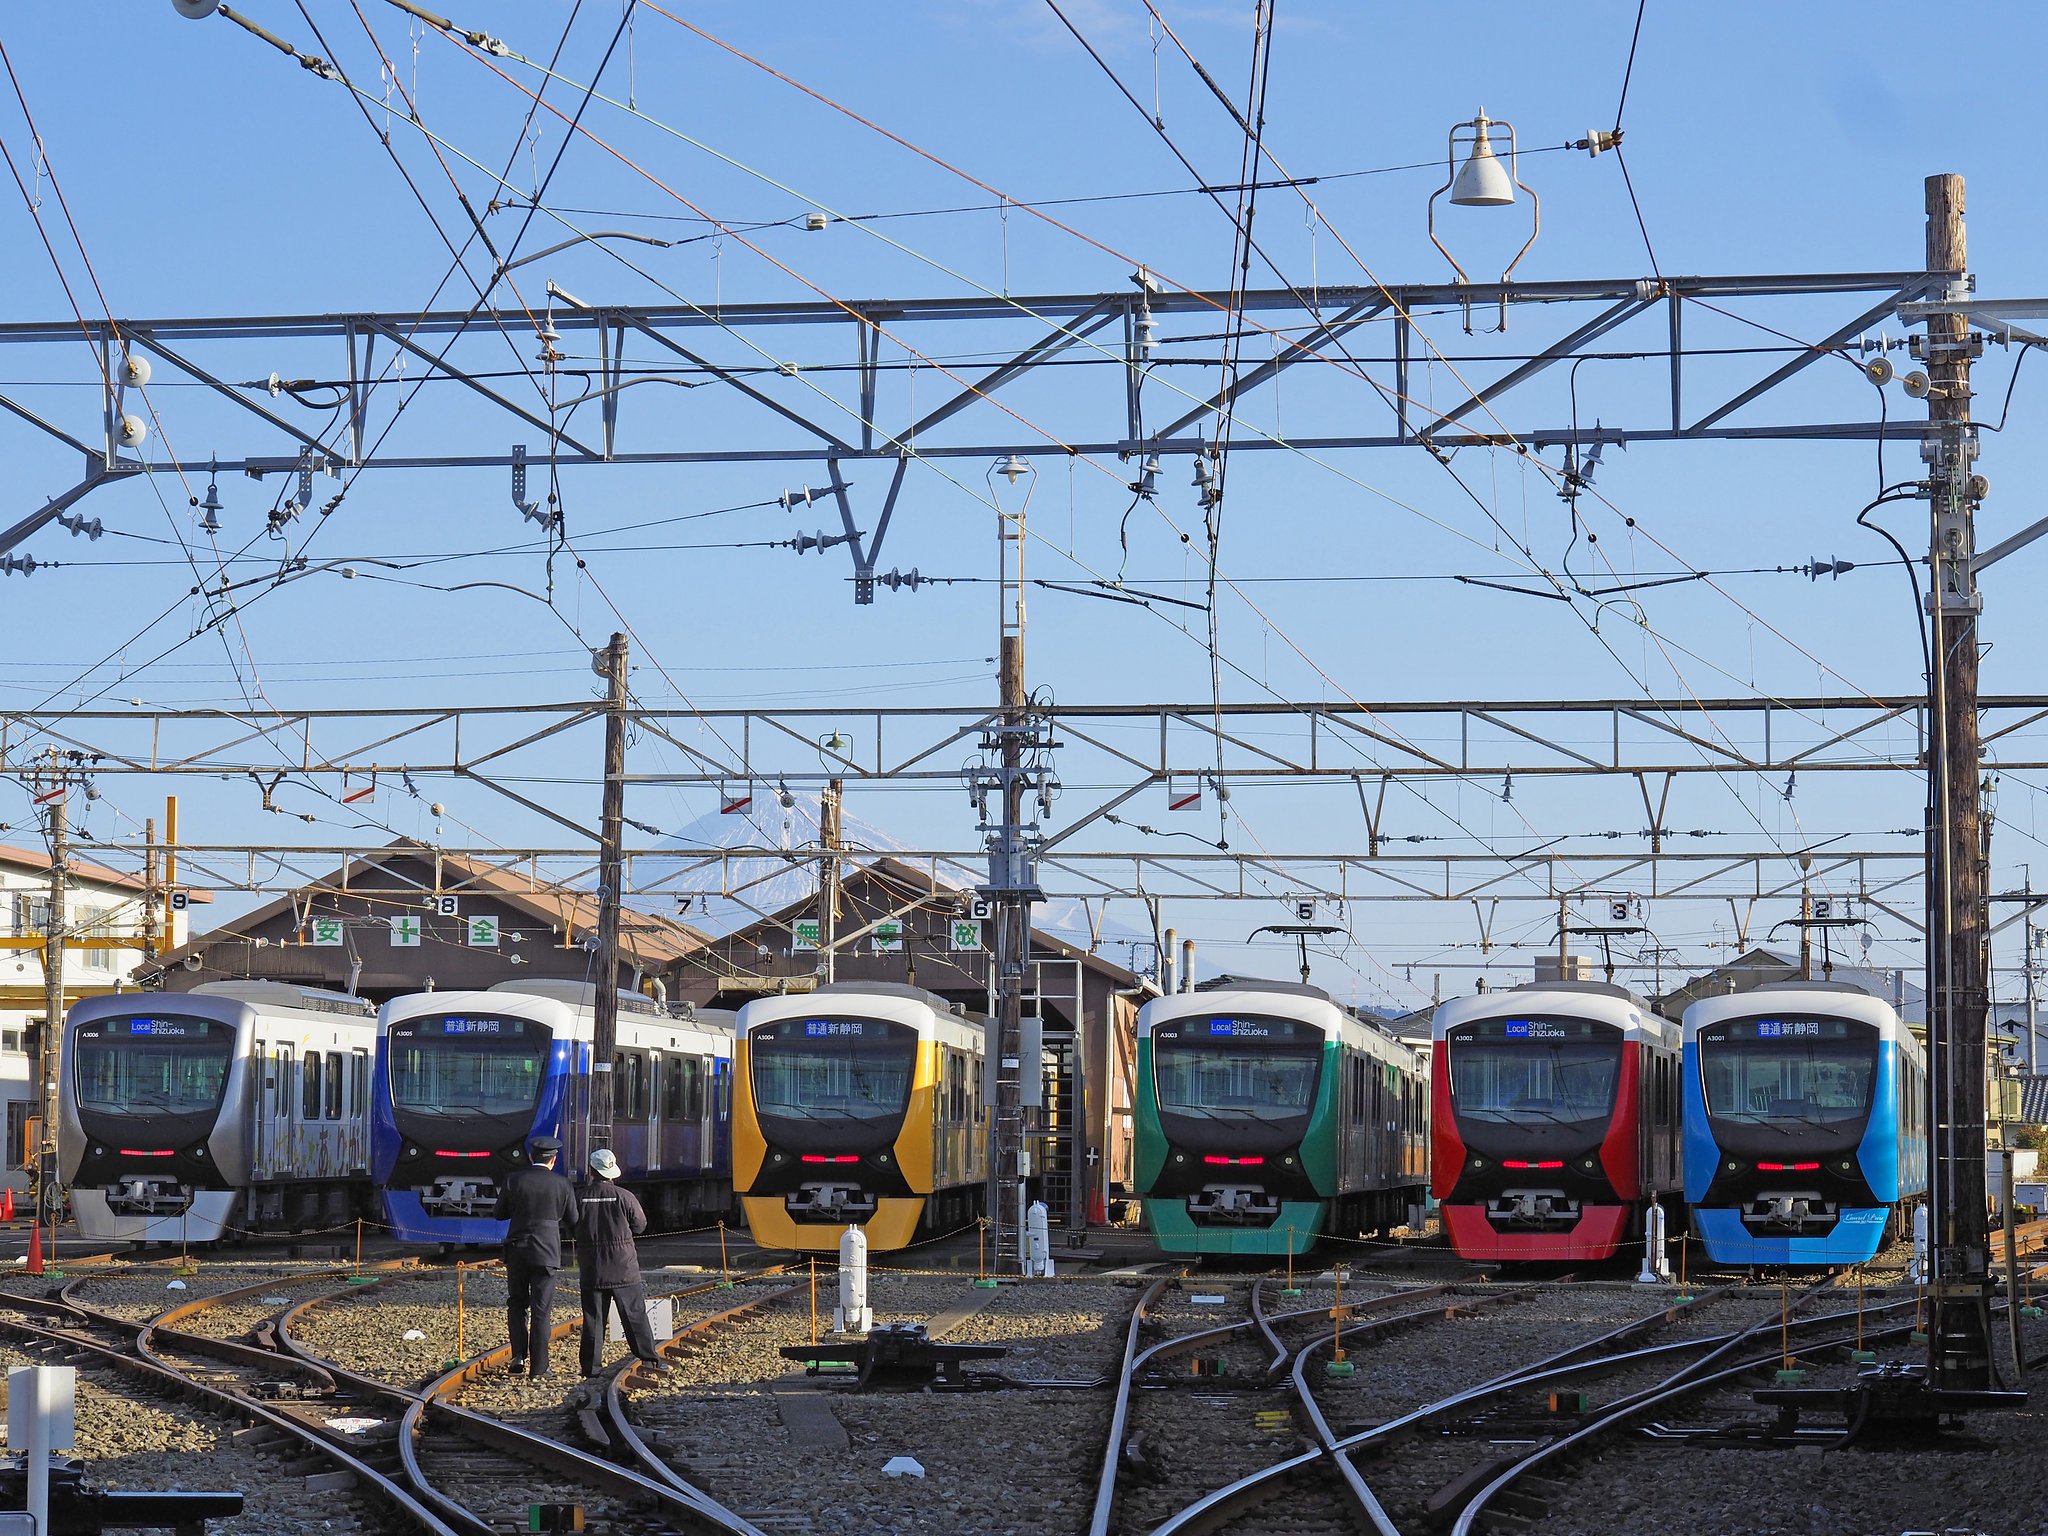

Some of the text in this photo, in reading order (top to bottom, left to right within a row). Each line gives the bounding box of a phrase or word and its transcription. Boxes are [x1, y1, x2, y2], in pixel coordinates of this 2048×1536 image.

[173, 893, 187, 910] 9
[441, 898, 455, 913] 8
[677, 898, 692, 915] 7
[974, 903, 989, 917] 6
[1299, 903, 1313, 919] 5
[1612, 903, 1628, 921] 3
[1815, 901, 1829, 917] 2
[131, 1022, 151, 1031] Local
[151, 1027, 185, 1035] shizuoka
[1211, 1023, 1231, 1031] Local
[1232, 1028, 1268, 1036] shizuoka
[1506, 1024, 1527, 1033] Local
[1528, 1029, 1565, 1037] shizuoka
